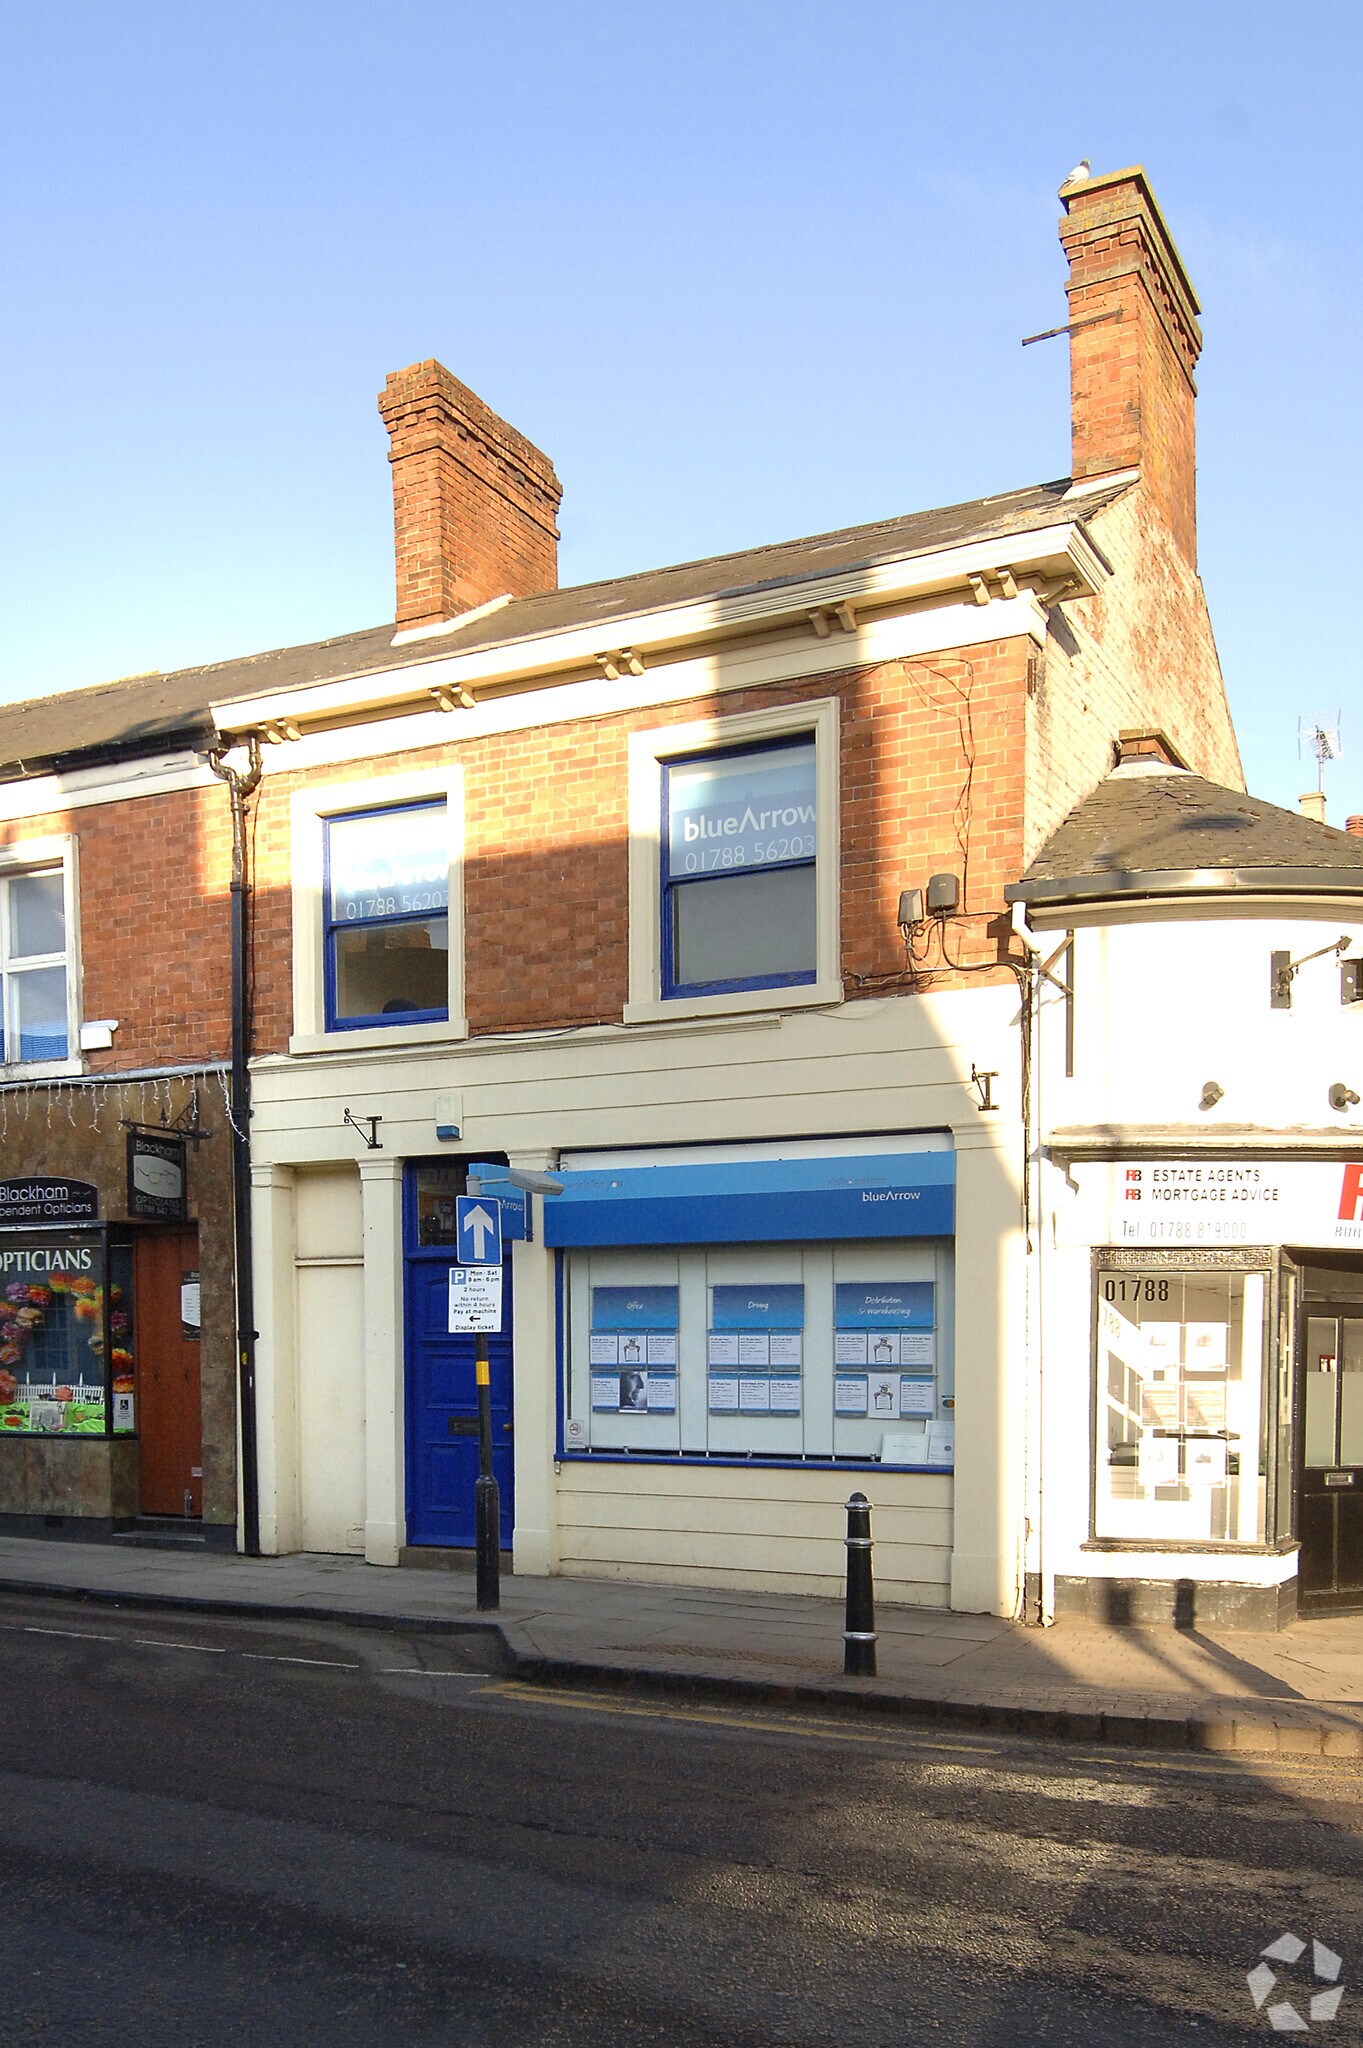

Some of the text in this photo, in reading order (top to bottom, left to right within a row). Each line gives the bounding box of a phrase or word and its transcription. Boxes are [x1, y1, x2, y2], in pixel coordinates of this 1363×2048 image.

[684, 805, 816, 842] blueArrow
[685, 834, 816, 872] 01788 56203
[346, 896, 396, 920] 01788
[136, 1140, 180, 1158] Blackham
[1153, 1169, 1202, 1182] ESTATE
[1208, 1169, 1260, 1182] AGENTS
[0, 1184, 68, 1201] Blackham
[862, 1190, 921, 1202] blueArrow
[1152, 1188, 1227, 1201] MORTGAGE
[1232, 1188, 1279, 1201] ADVICE
[44, 1203, 92, 1216] Opticians
[500, 1199, 523, 1212] Arrow
[1150, 1221, 1191, 1238] 01788
[0, 1249, 92, 1272] PTICIANS
[1105, 1279, 1169, 1302] 01788
[747, 1301, 769, 1313] Driving
